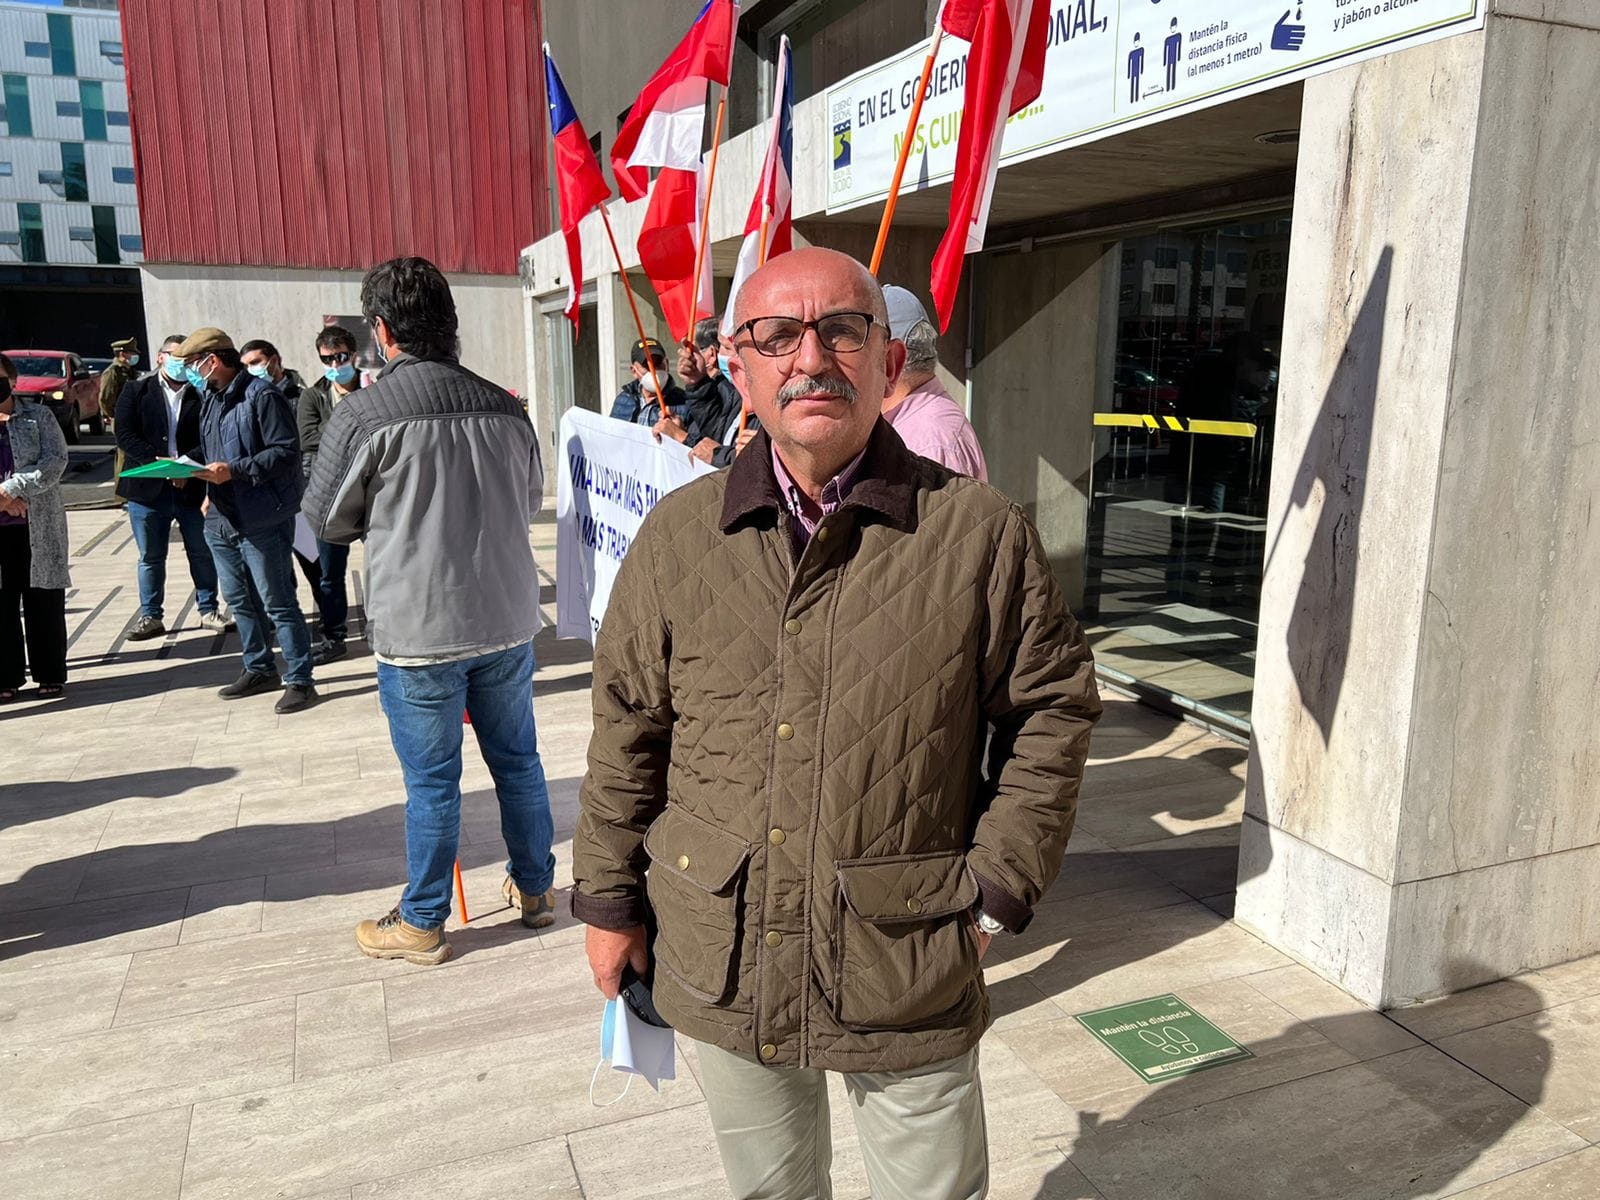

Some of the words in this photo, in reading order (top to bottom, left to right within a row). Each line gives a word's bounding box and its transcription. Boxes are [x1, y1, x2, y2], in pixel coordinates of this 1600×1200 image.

[1189, 24, 1219, 42] Mantén
[1220, 20, 1228, 32] la
[1333, 18, 1341, 32] y
[1341, 7, 1371, 29] jabón
[1374, 5, 1381, 15] o
[1187, 65, 1197, 78] (al
[1199, 57, 1225, 74] menos
[1226, 53, 1231, 65] 1
[1233, 42, 1263, 62] metro)
[1188, 38, 1224, 60] distancia
[1225, 31, 1248, 47] física
[859, 96, 876, 128] EN
[880, 88, 896, 119] EL
[901, 55, 967, 110] GOBIERN
[594, 462, 622, 507] LUCHA
[624, 469, 643, 517] MÁS
[582, 512, 605, 552] MÁS
[1100, 1023, 1138, 1036] Mantén
[1149, 1010, 1192, 1025] distancia
